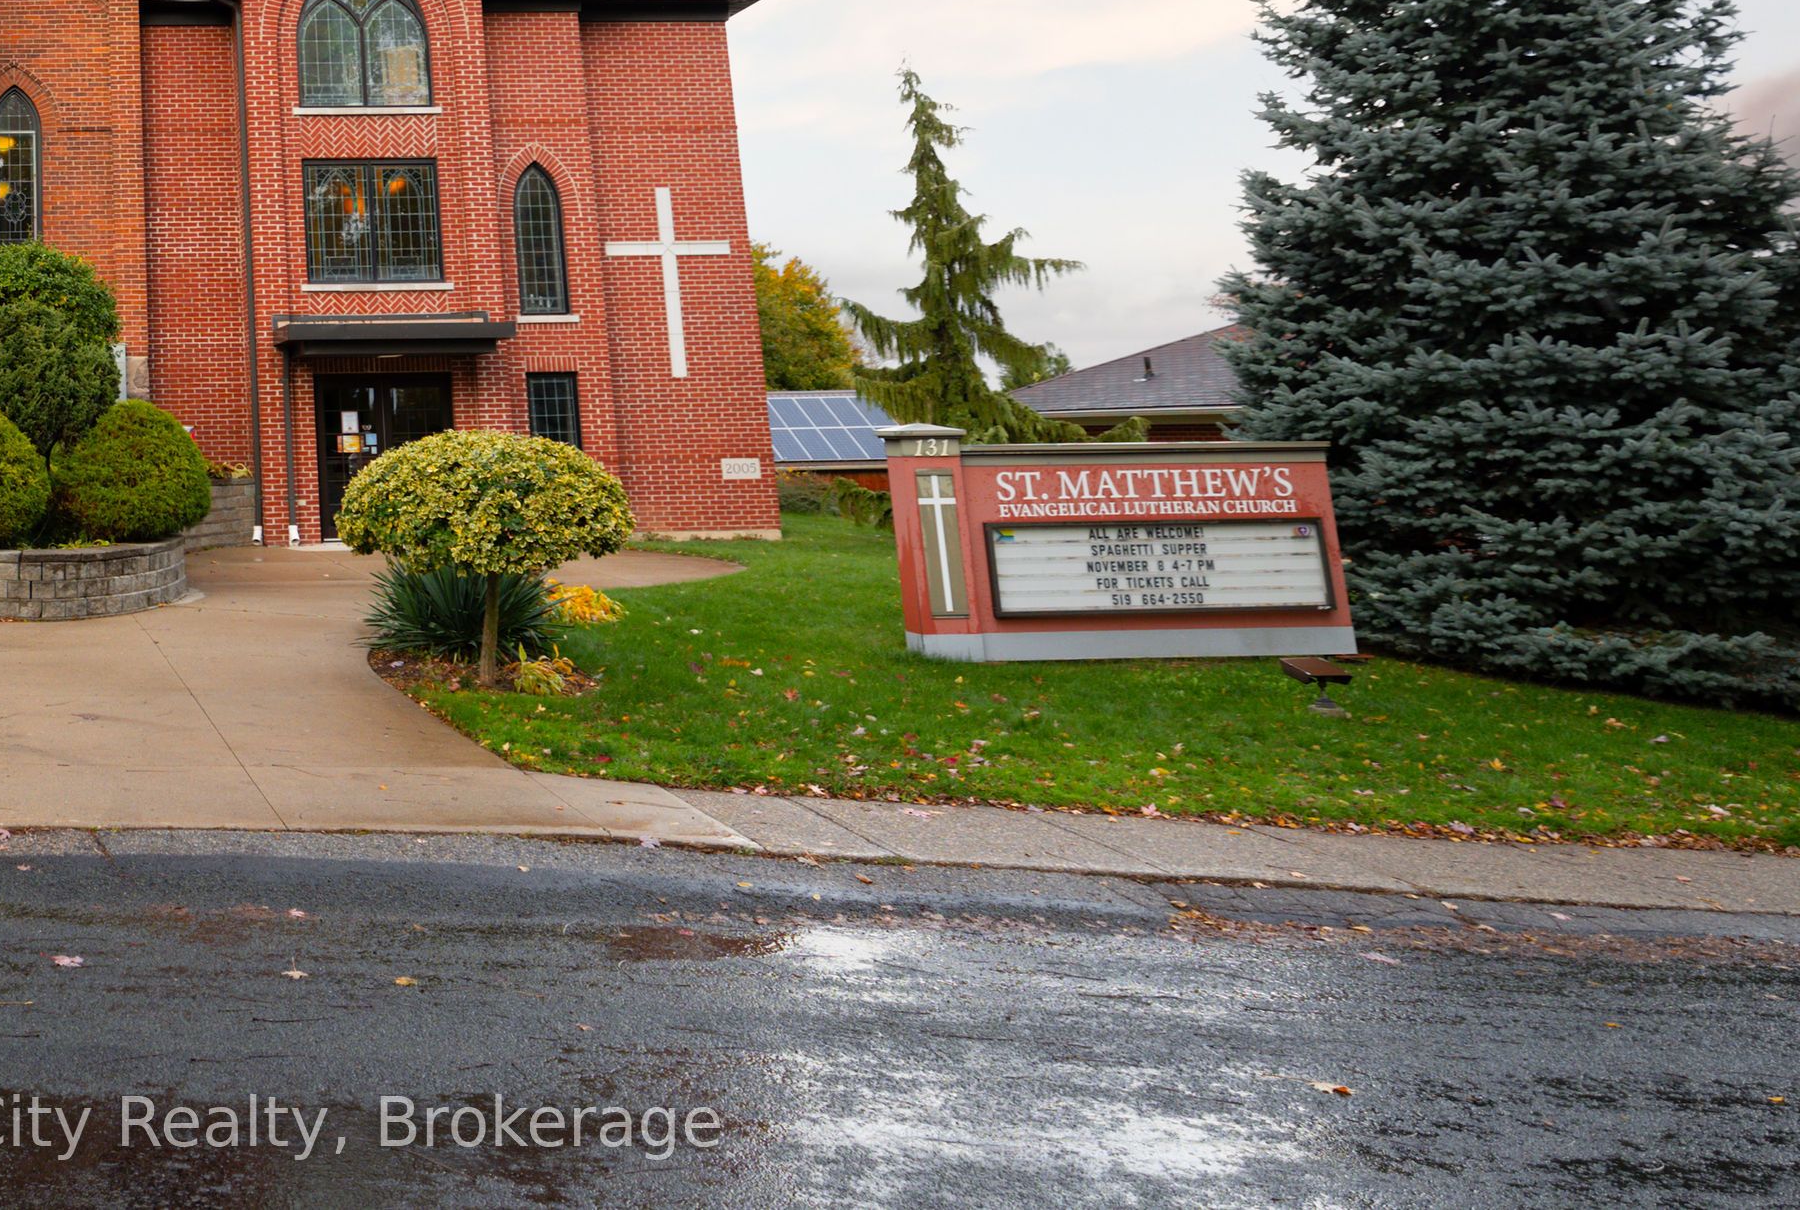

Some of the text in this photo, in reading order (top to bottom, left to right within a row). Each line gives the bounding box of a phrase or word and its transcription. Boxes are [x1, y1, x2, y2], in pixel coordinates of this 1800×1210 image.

[914, 438, 950, 457] 131
[725, 462, 757, 474] 2005
[995, 466, 1294, 502] ST. MATTHEW'S
[998, 499, 1298, 518] EVANGELICAL LUTHERAN CHURCH
[1088, 526, 1205, 540] ALL ARE WELCOME!
[1091, 543, 1208, 557] SPAGHETTI SUPPER
[1086, 560, 1149, 573] NOVEMBER
[1172, 559, 1192, 571] 4-7
[1197, 559, 1216, 571] PM
[1096, 575, 1210, 590] FOR TICKETS CALL
[1111, 593, 1204, 606] 519 664-2550
